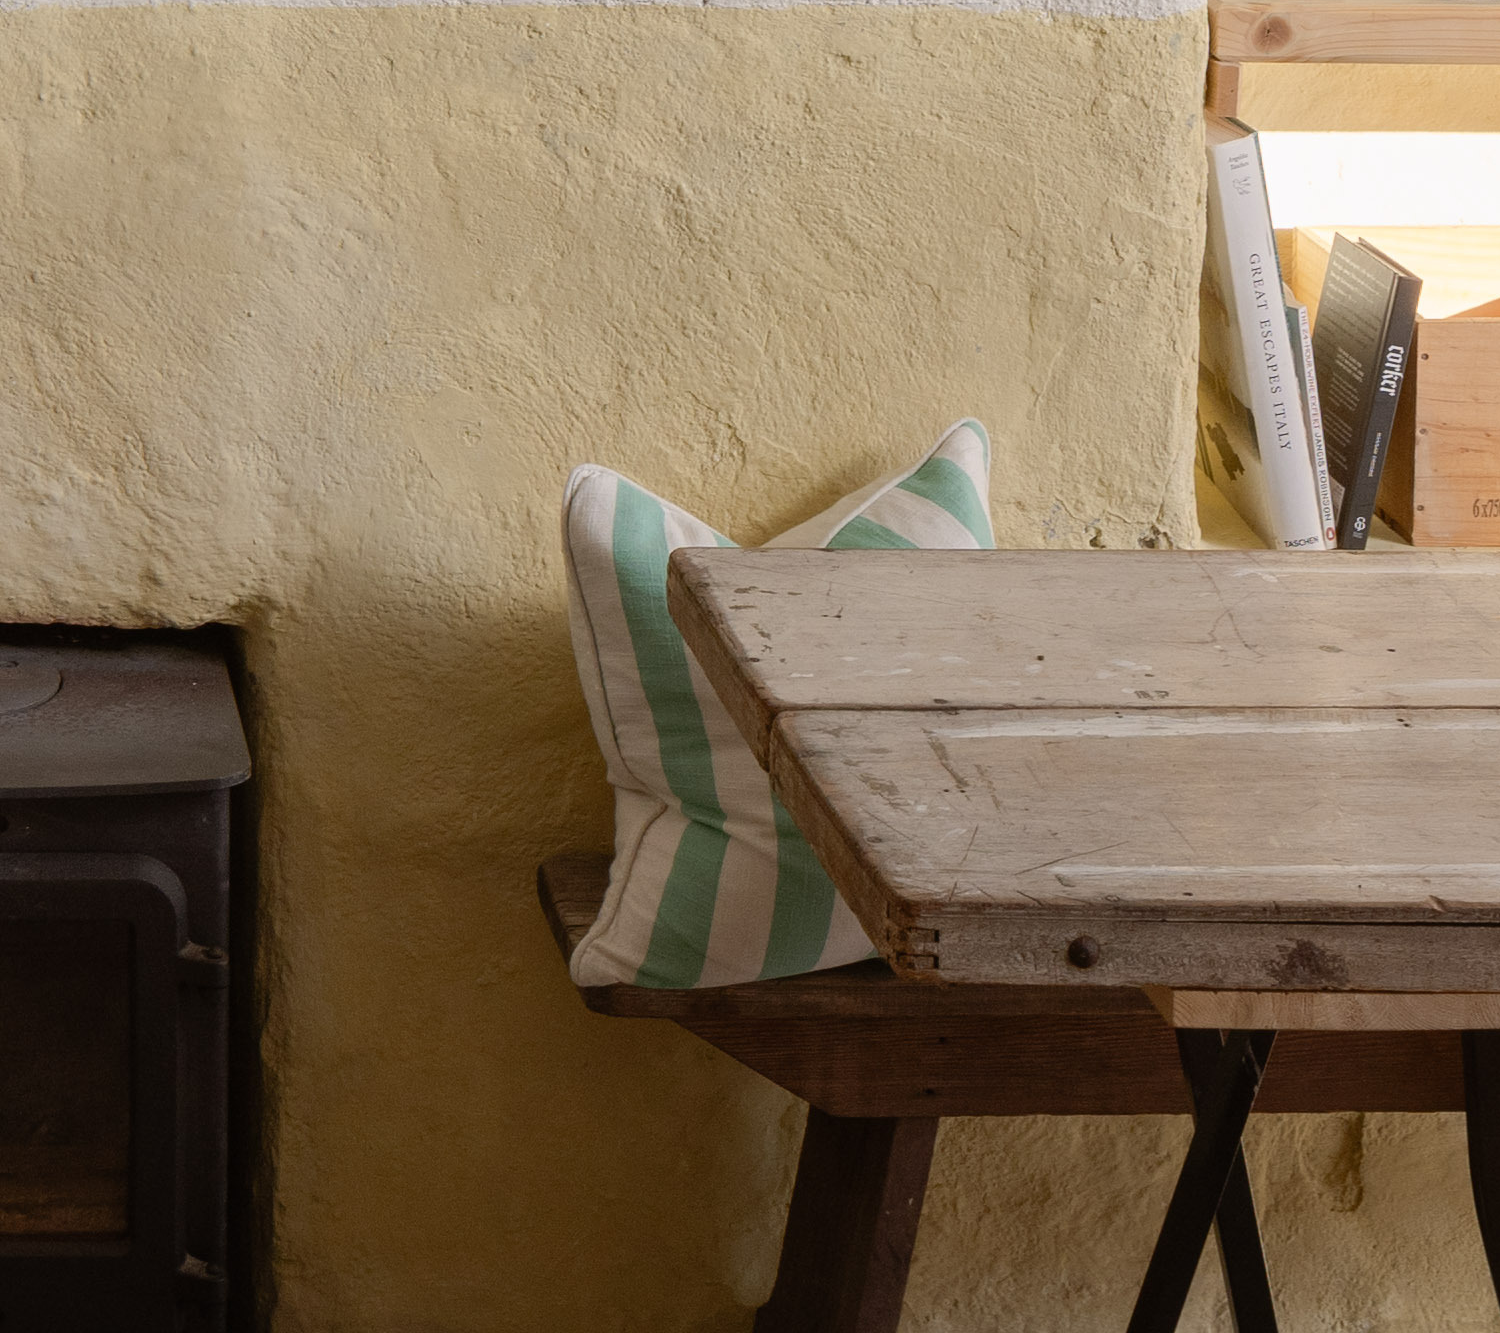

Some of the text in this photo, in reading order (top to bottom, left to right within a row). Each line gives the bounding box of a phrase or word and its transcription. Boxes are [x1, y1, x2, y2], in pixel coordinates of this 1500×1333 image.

[1249, 252, 1293, 452] GREAT ESCAPES ITALY
[1379, 344, 1405, 397] corker
[1318, 469, 1332, 521] ROBINSON
[1283, 537, 1319, 550] TASCHEN
